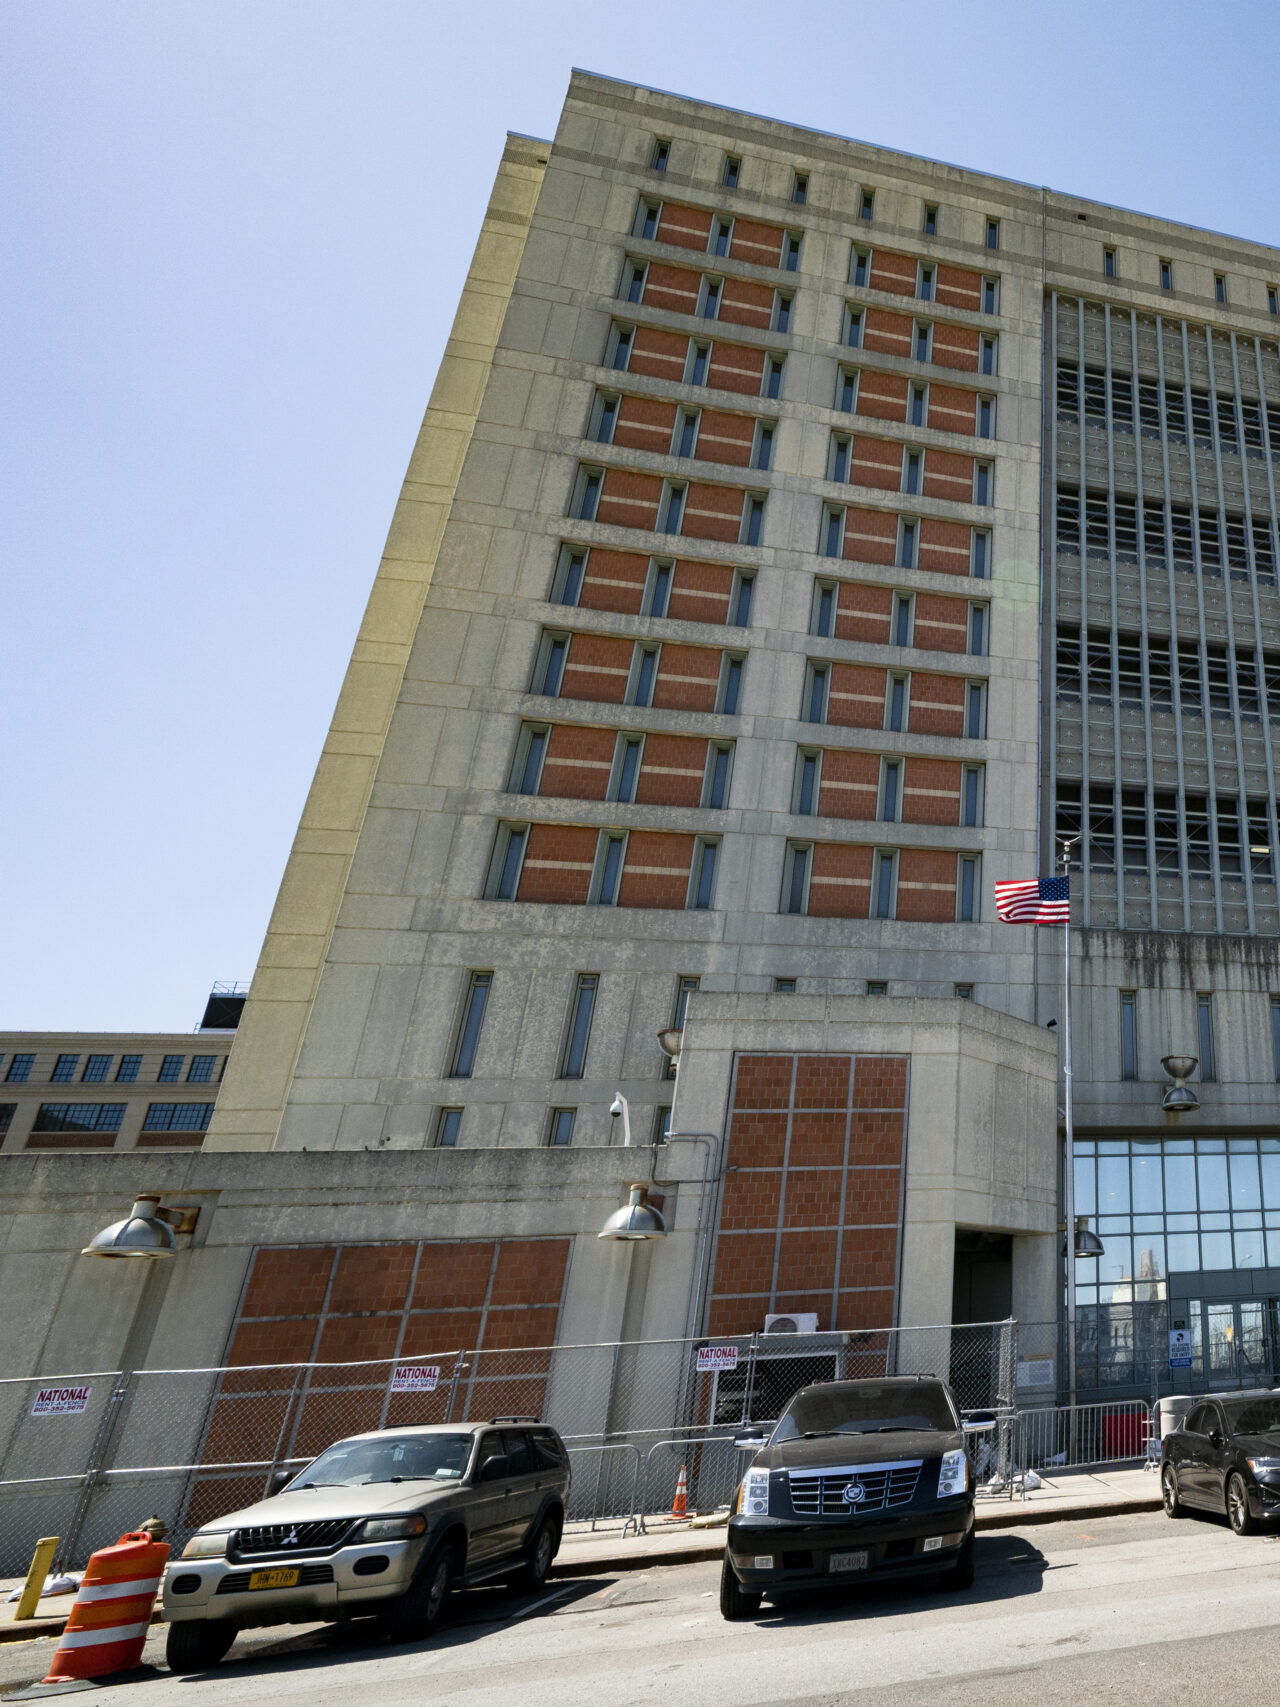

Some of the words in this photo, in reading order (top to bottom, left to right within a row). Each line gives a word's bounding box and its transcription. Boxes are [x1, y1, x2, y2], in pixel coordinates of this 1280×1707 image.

[699, 1348, 736, 1359] NATIONAL
[394, 1367, 437, 1379] NATIONAL
[37, 1386, 89, 1402] NATIONAL
